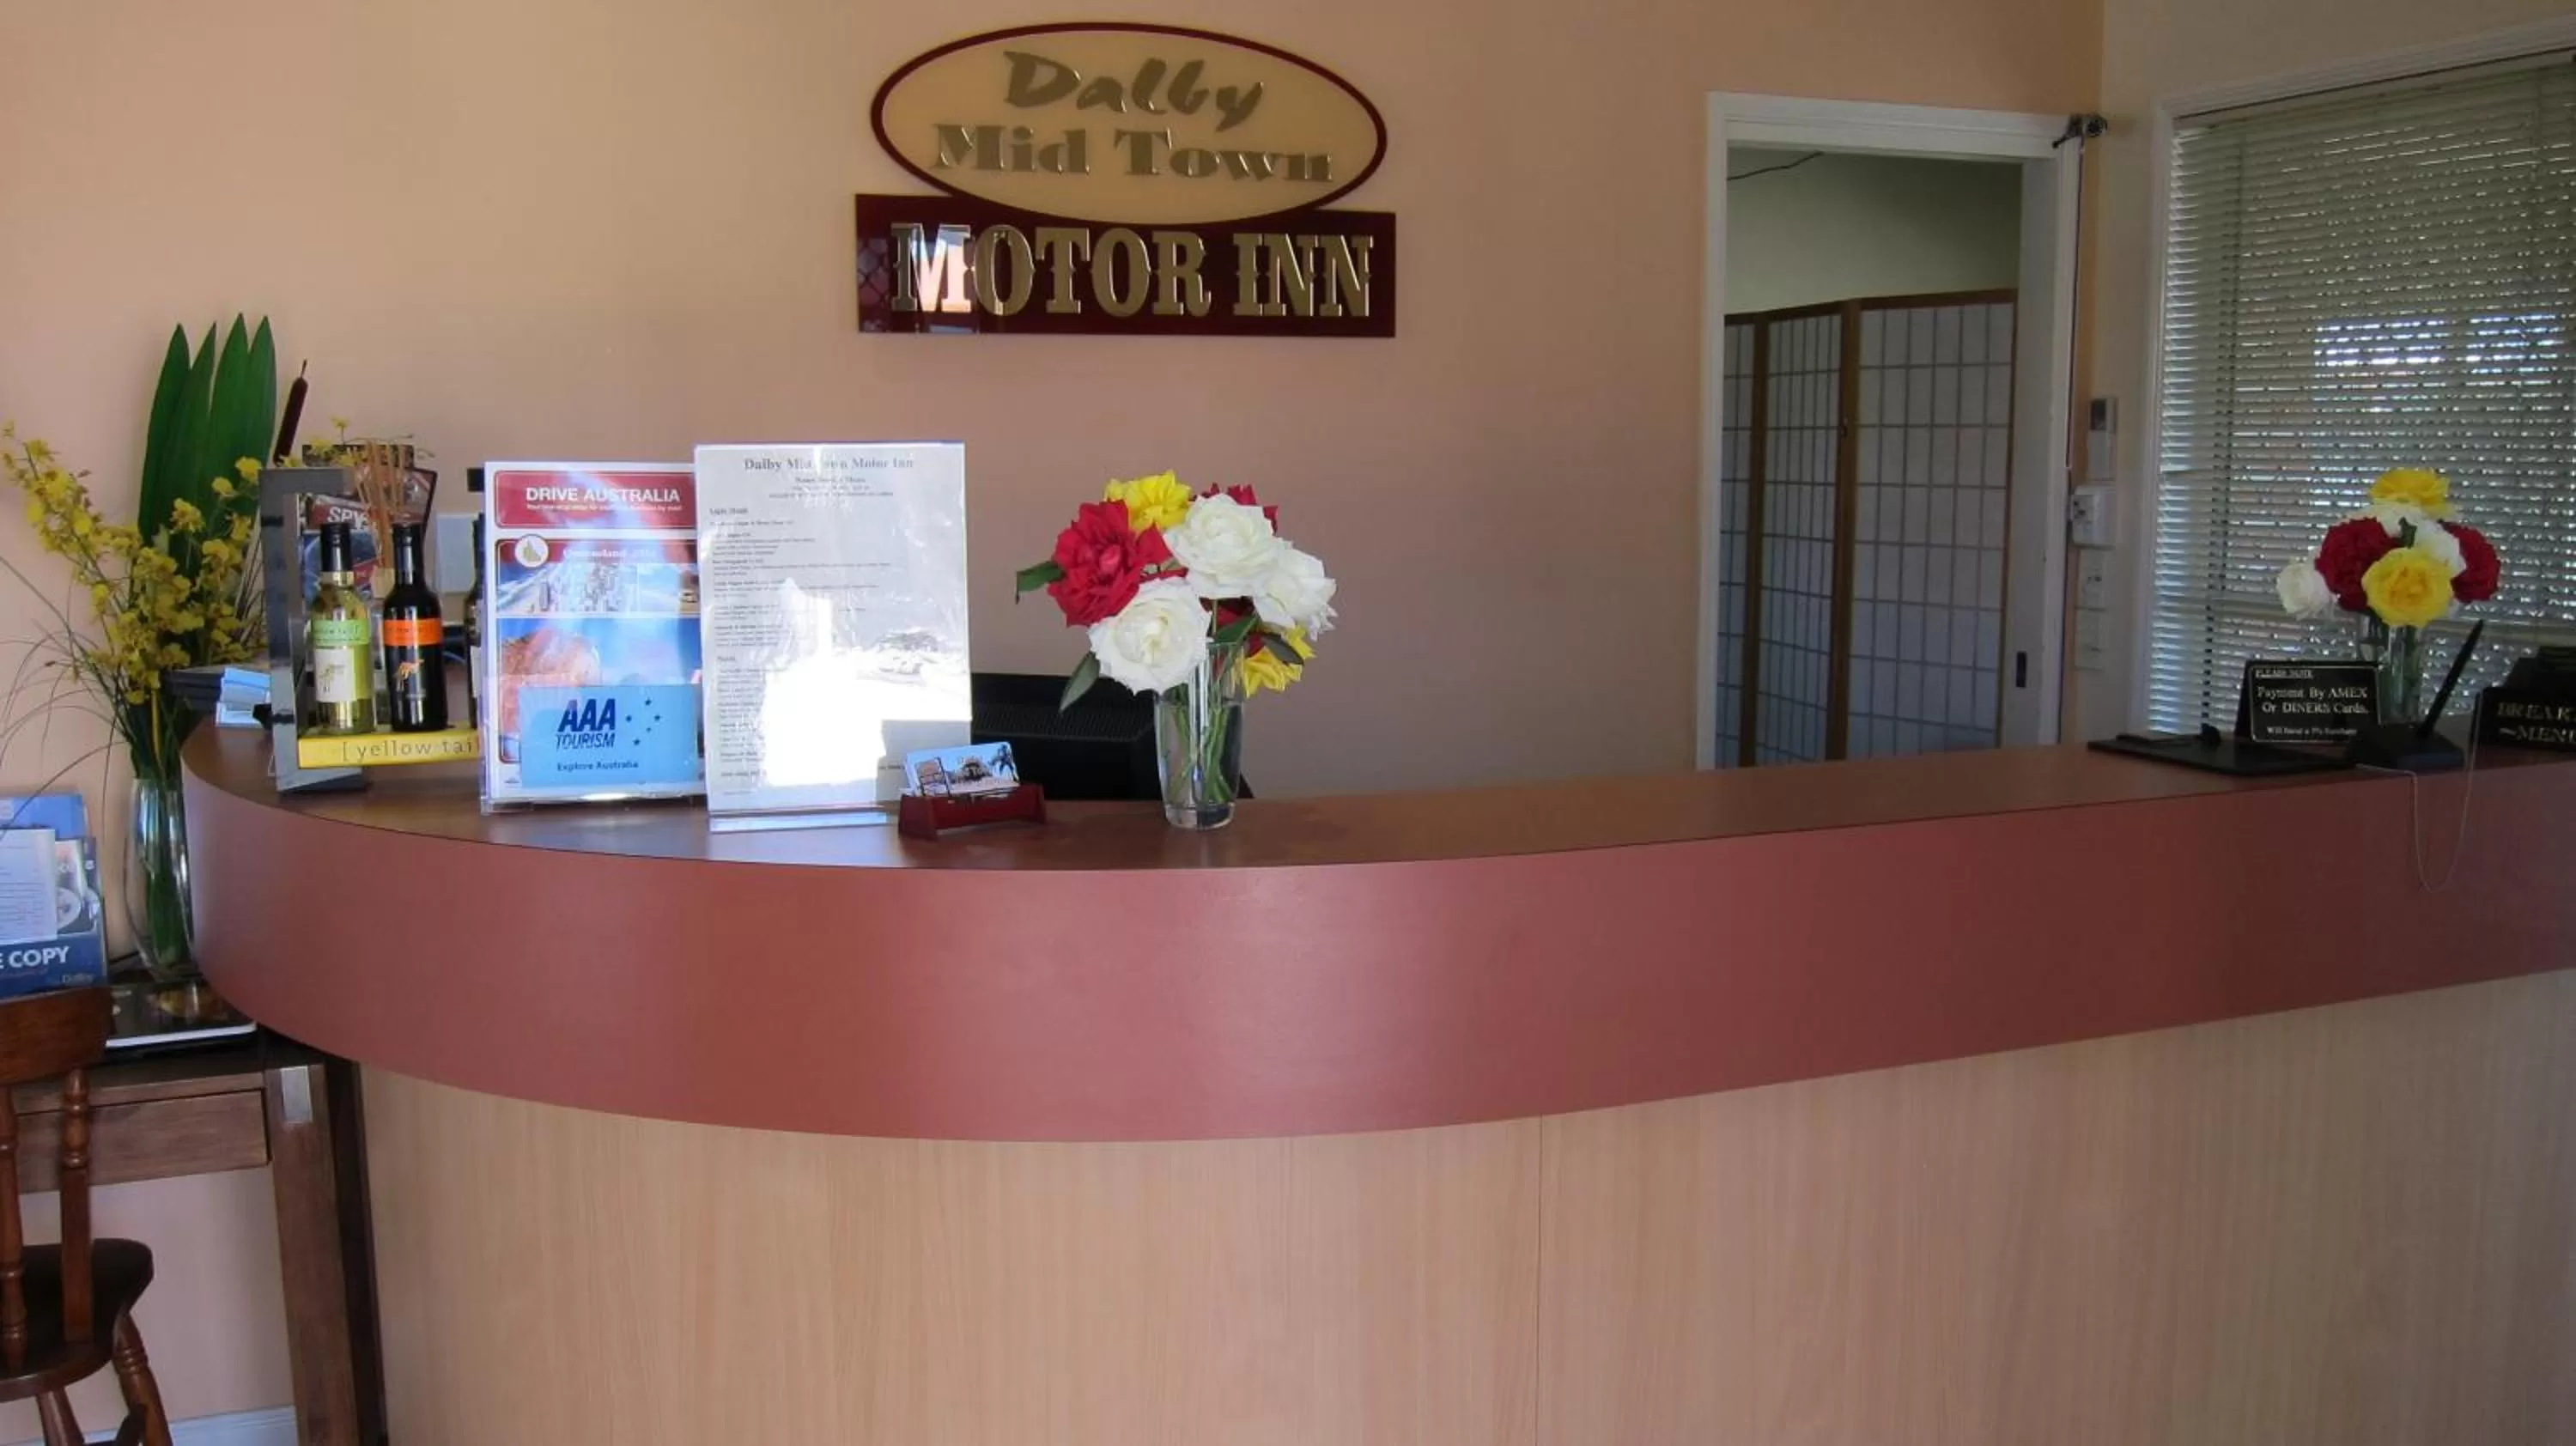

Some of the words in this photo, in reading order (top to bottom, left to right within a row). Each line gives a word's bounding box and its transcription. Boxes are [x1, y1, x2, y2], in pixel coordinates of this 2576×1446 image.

[1003, 50, 1263, 133] Dalby
[932, 123, 1091, 176] Mid
[1114, 129, 1334, 182] Town
[890, 222, 1212, 318] MOTOR
[1233, 232, 1374, 318] INN
[744, 459, 782, 472] Dalby
[526, 487, 579, 501] DRIVE
[584, 487, 681, 503] AUSTRALIA
[2257, 686, 2305, 700] Payment
[2309, 686, 2326, 700] By
[2328, 686, 2368, 698] AMEX
[557, 698, 616, 732] AAA
[2262, 702, 2278, 714] Or
[2281, 702, 2331, 714] DINERS
[357, 739, 432, 763] yellow
[556, 732, 616, 750] TOURISM
[557, 761, 593, 772] Explore
[596, 760, 639, 770] Australia
[9, 945, 70, 969] COPY
